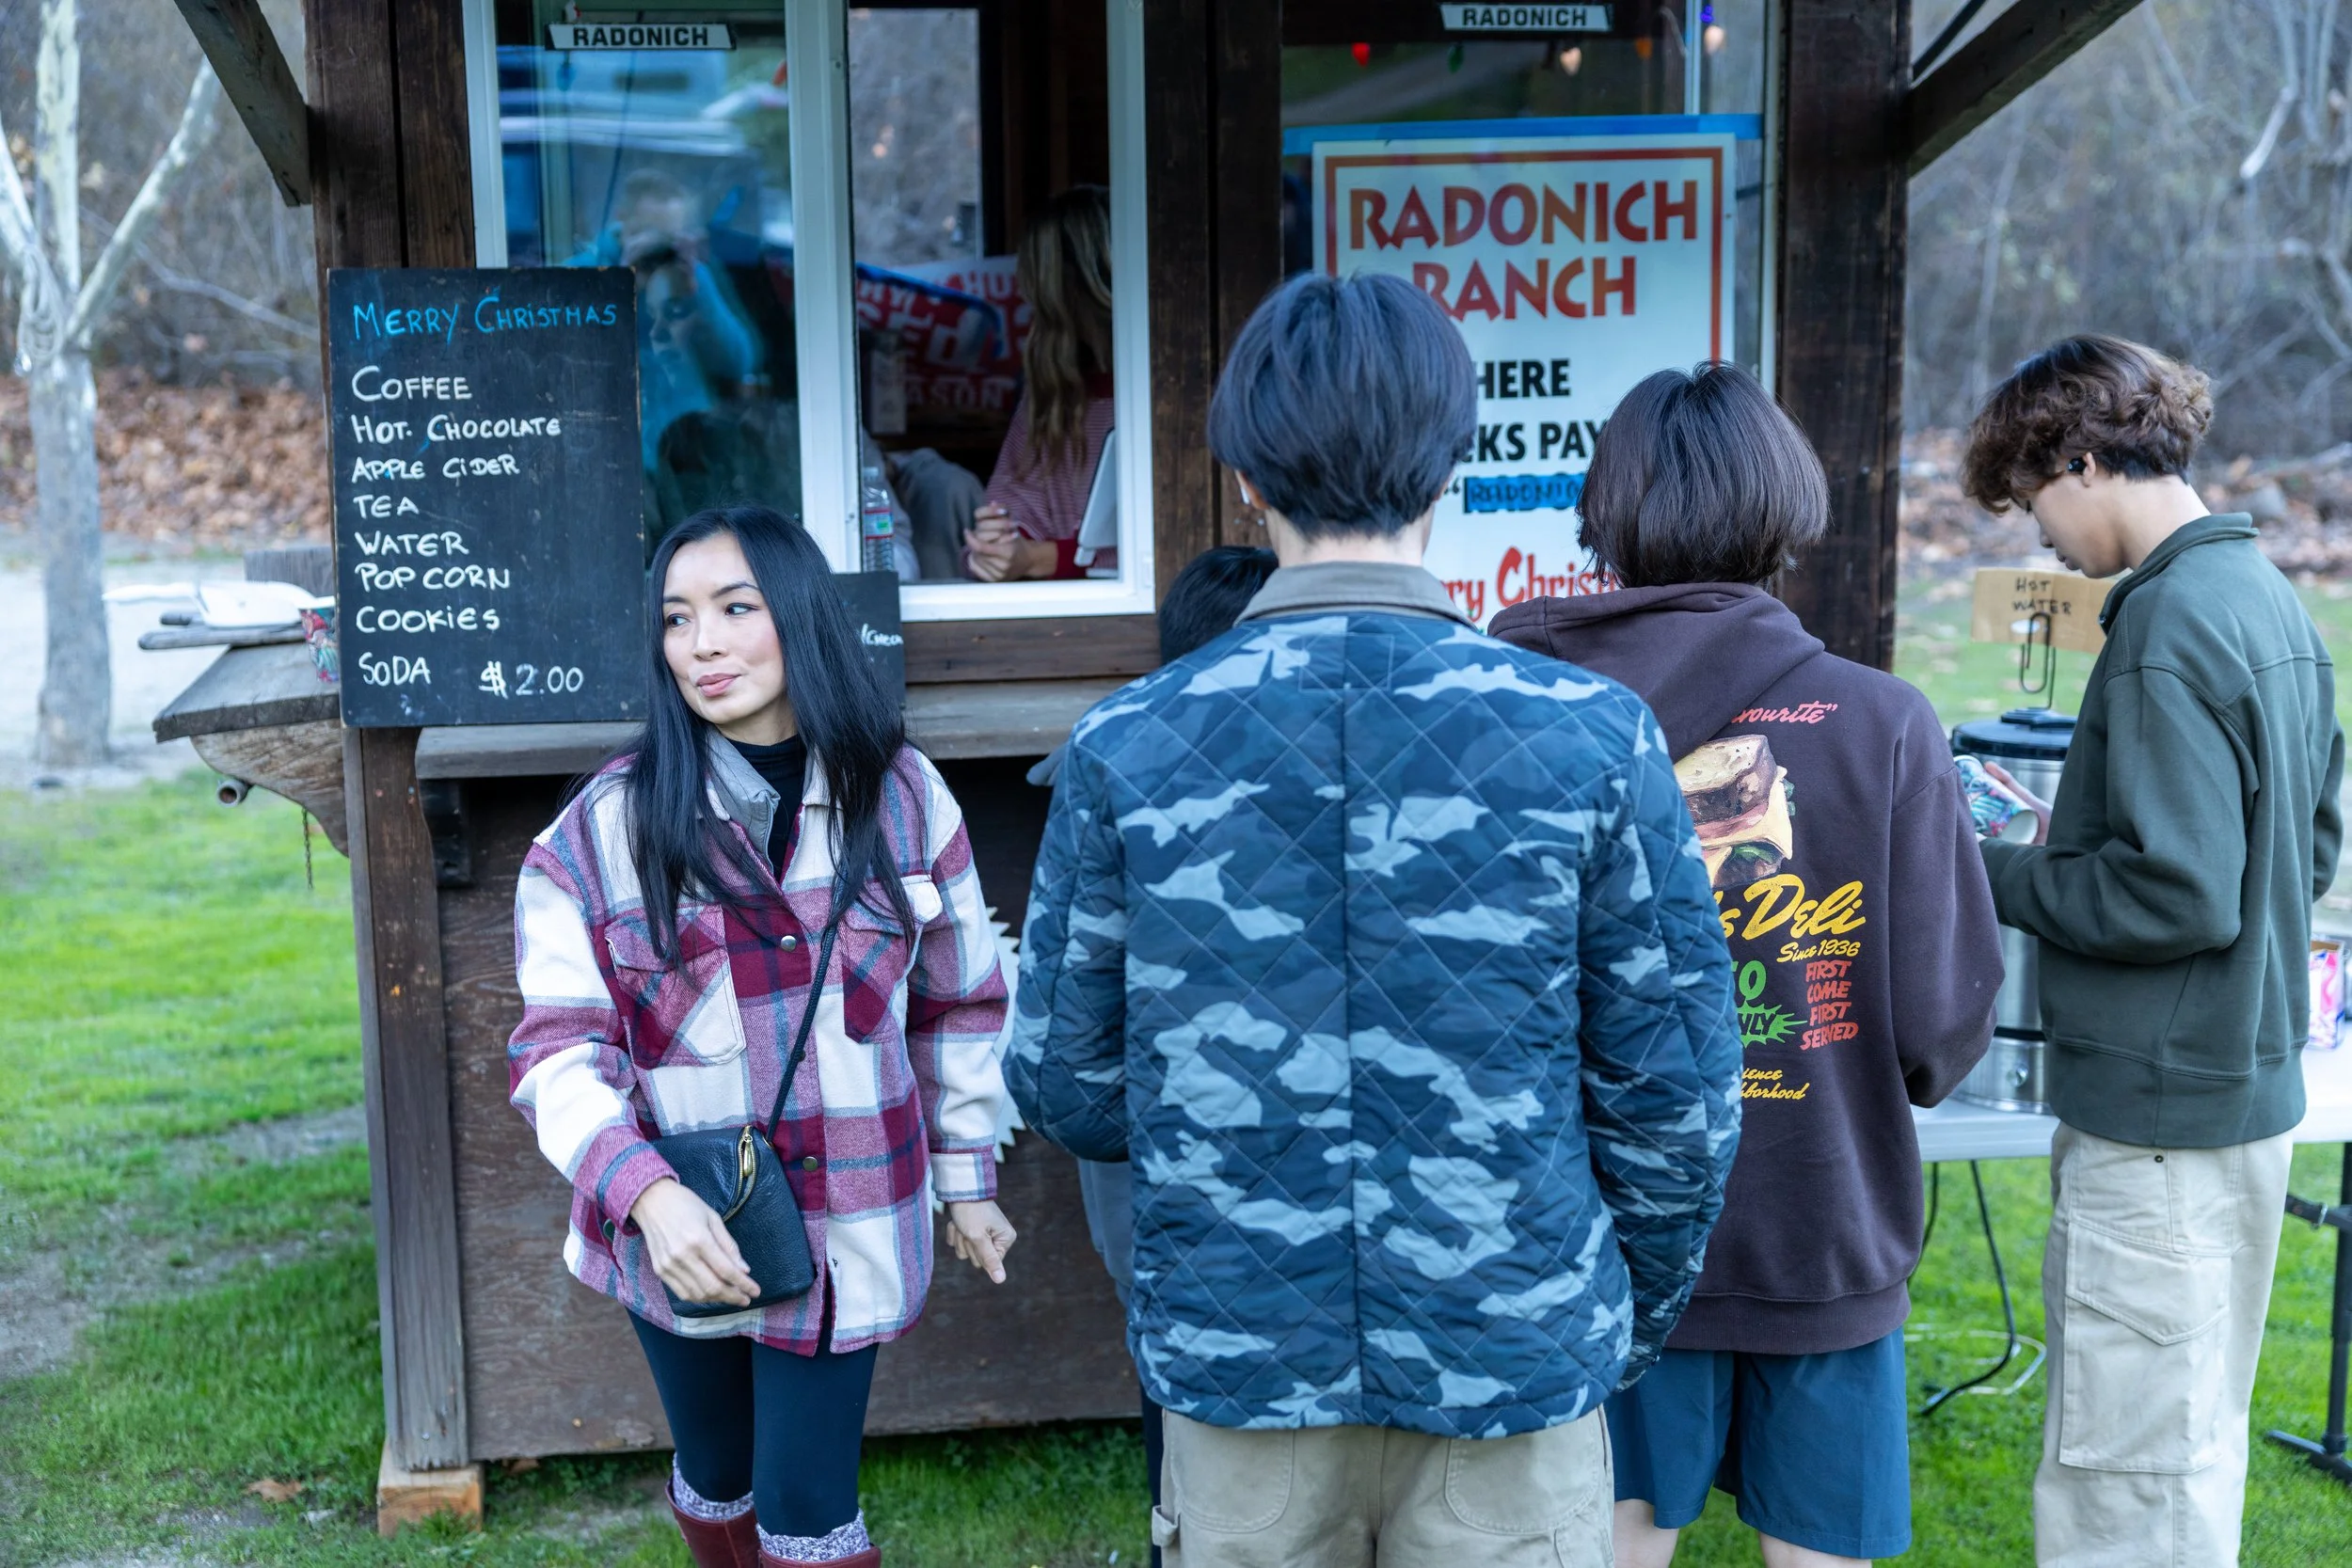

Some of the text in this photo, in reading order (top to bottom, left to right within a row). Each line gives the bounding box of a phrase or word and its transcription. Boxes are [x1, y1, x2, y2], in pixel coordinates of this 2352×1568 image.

[1462, 8, 1587, 26] RADONICH
[573, 26, 708, 46] RADONICH
[1349, 180, 1699, 251] RADONICH
[1413, 256, 1637, 323] RANCH
[354, 302, 458, 347] MERRY
[352, 366, 472, 403] COFFEE
[1476, 358, 1572, 400] HERE
[427, 414, 562, 442] CHOCOLATE
[352, 453, 519, 483] APPLE CIDER
[354, 495, 420, 519] TEA
[355, 531, 469, 557] WATER
[355, 562, 510, 592] POP CORN
[356, 605, 501, 633] COOKIES
[2012, 598, 2072, 615] WATER
[358, 652, 432, 687] SODA
[1741, 874, 1866, 941] Deli
[1777, 940, 1861, 962] Since 1936
[1805, 959, 1851, 983] FIRST
[1806, 981, 1851, 1004] COME
[1809, 1002, 1851, 1026] FIRST
[1800, 1022, 1859, 1051] SERVED
[1741, 1068, 1783, 1081] ience
